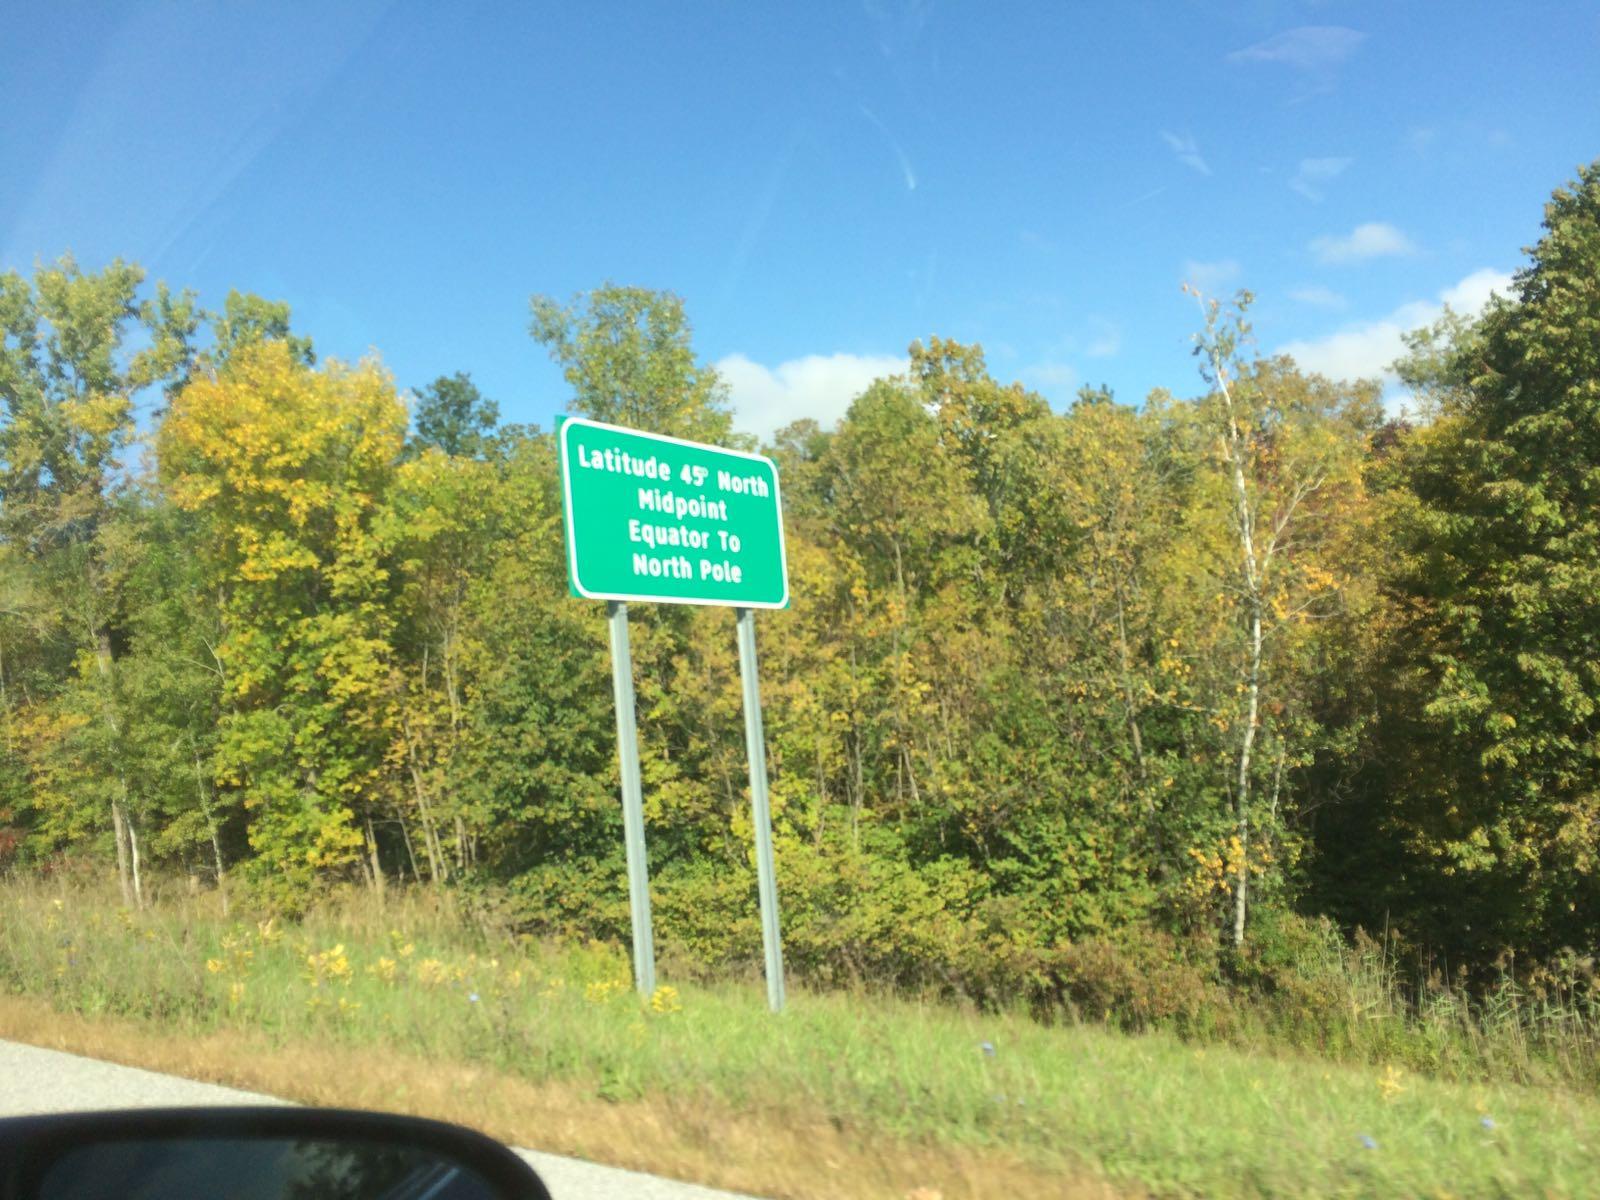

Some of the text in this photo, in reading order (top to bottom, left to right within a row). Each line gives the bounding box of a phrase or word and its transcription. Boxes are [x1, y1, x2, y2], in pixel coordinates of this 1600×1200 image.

[577, 444, 671, 482] Latitude
[717, 470, 769, 498] North
[638, 488, 728, 521] Midpoint
[628, 519, 741, 553] Equator To
[632, 553, 742, 584] North Pole
